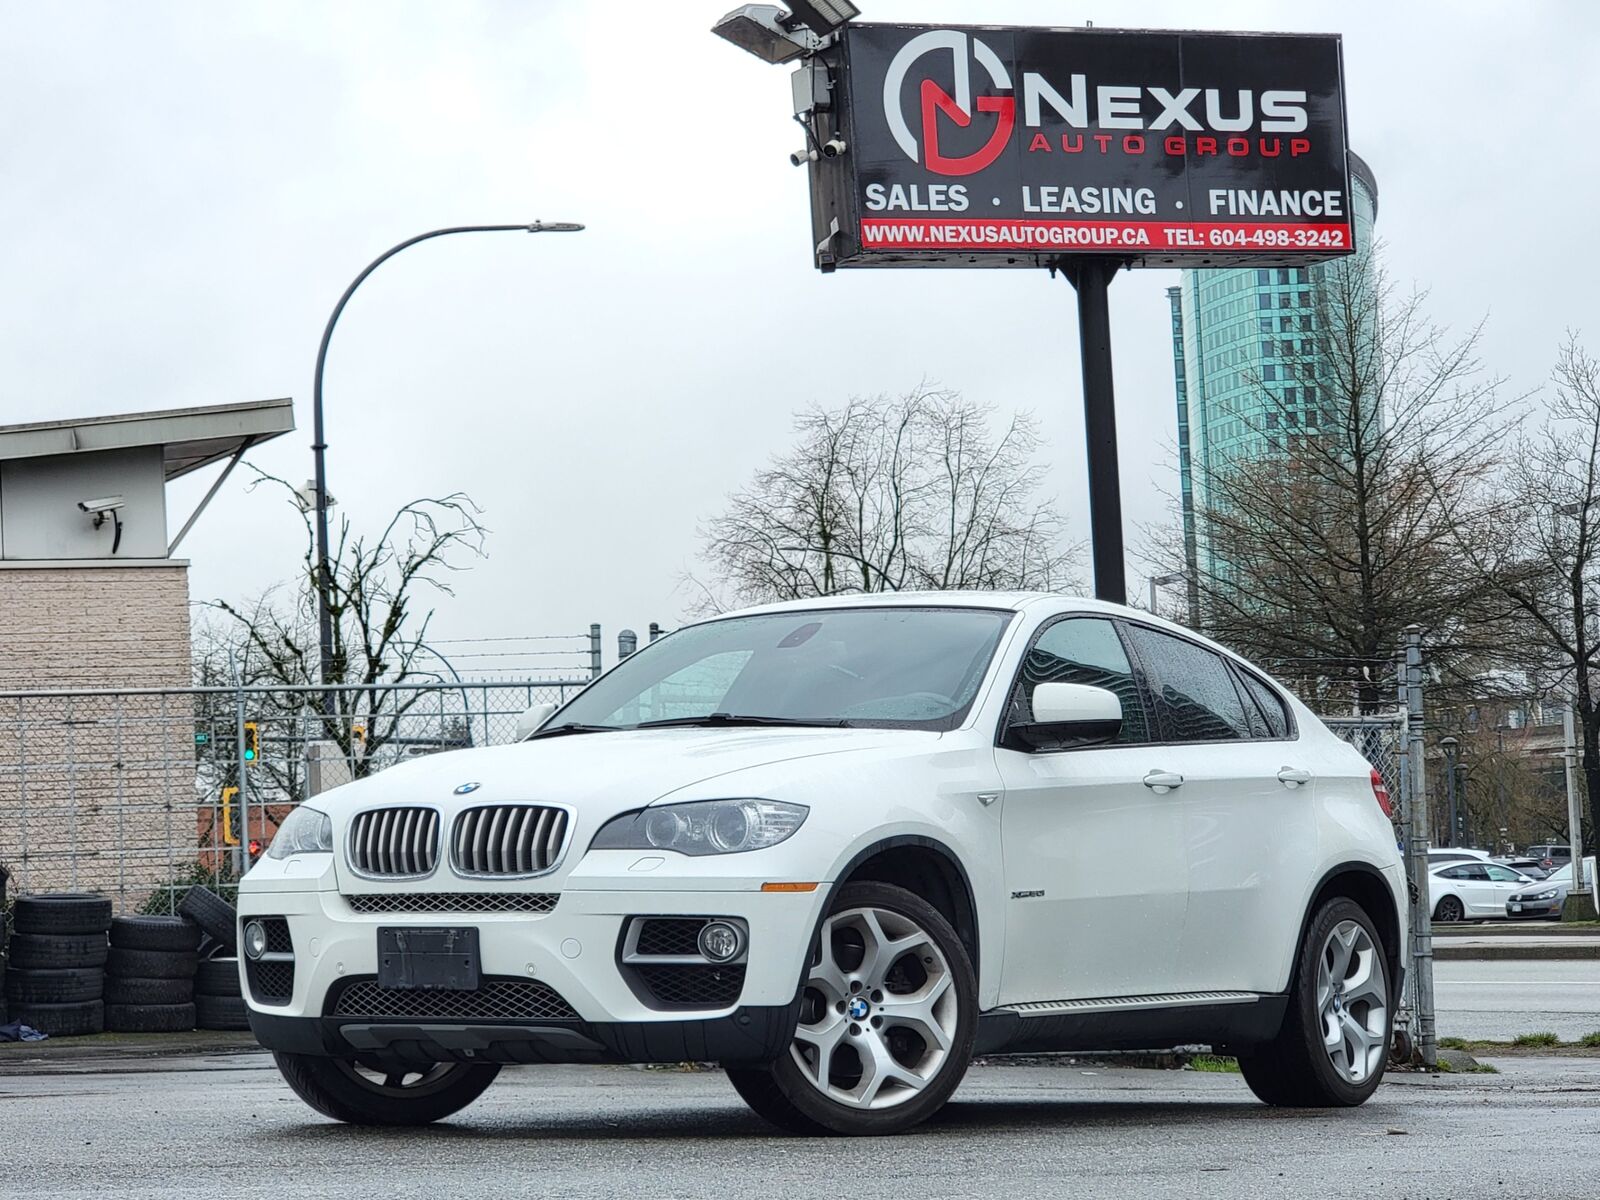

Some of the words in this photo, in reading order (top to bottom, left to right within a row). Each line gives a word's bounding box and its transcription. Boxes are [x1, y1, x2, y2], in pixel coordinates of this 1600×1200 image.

[1023, 72, 1308, 133] NEXUS
[1029, 133, 1145, 155] AUTO
[1164, 136, 1311, 157] GROUP
[865, 183, 970, 211] SALES
[1022, 186, 1157, 214] LEASING
[1209, 189, 1343, 216] FINANCE
[864, 224, 1150, 245] WWW.NEXUSAUTOGROUP.CA
[1163, 228, 1205, 245] TEL:
[1209, 229, 1344, 247] 604-498-3242
